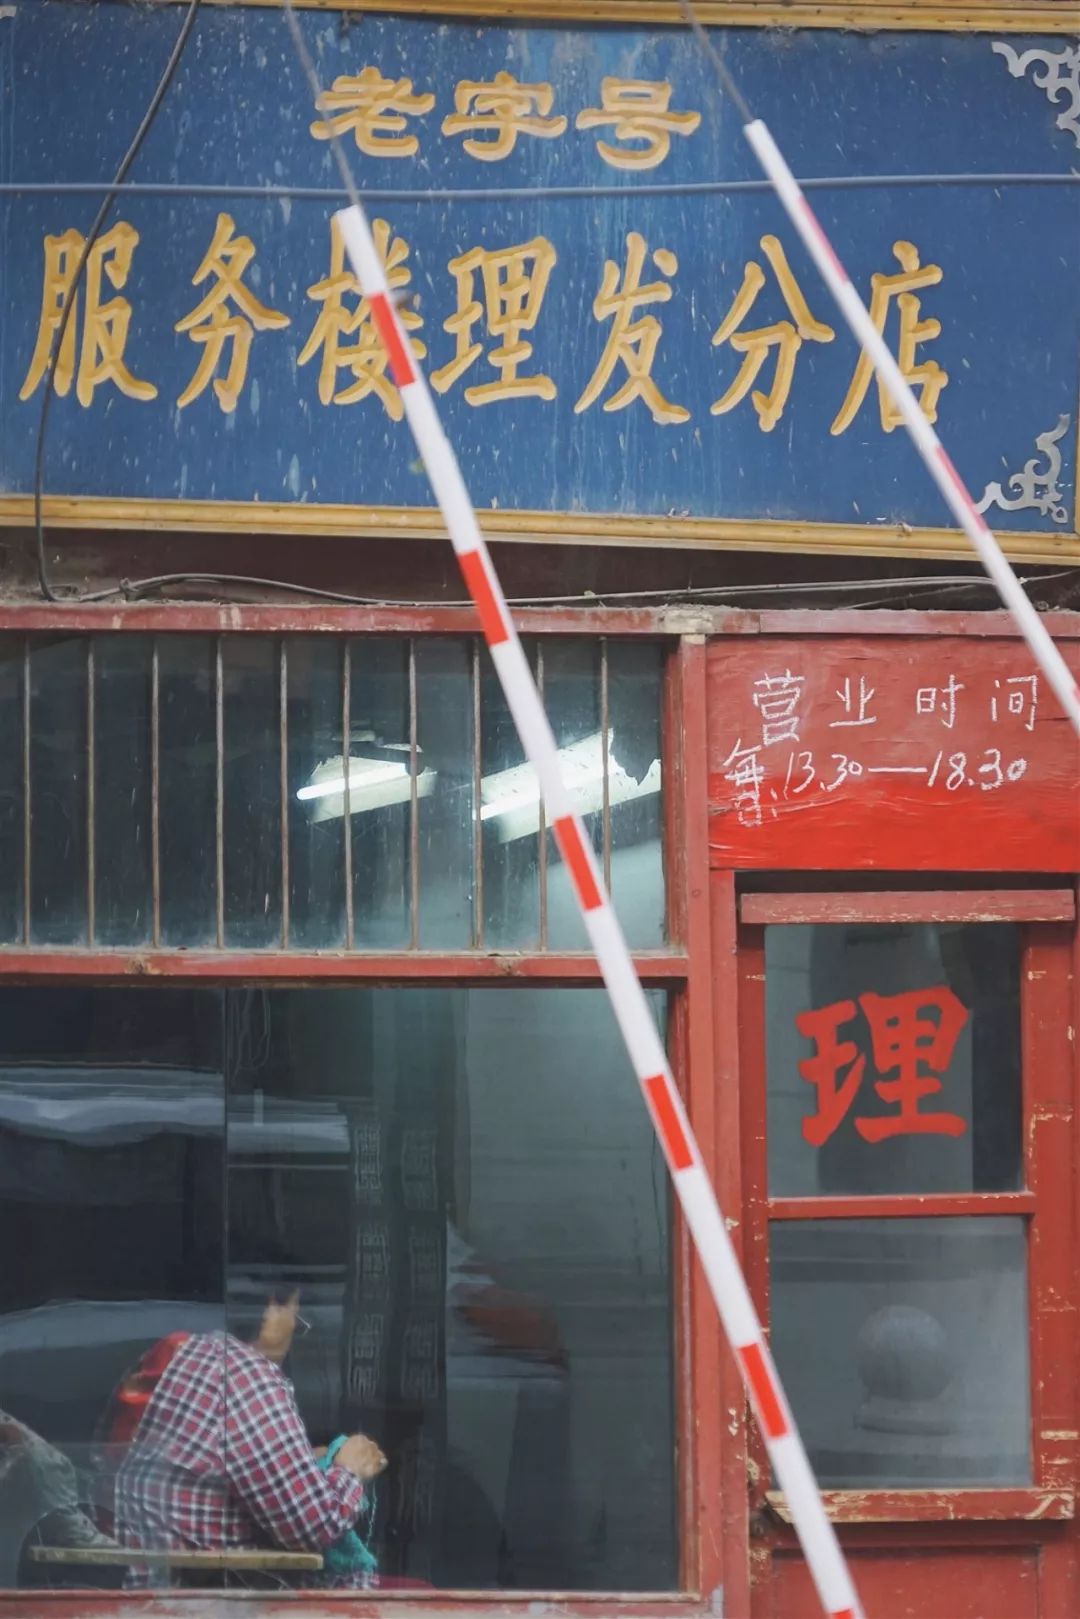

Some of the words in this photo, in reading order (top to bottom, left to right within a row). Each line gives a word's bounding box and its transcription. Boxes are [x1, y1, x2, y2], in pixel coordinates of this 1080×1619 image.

[310, 66, 703, 171] 老字号
[19, 213, 949, 437] 服务楼理发分店
[752, 669, 1038, 745] 营业时间
[795, 985, 969, 1147] 理
